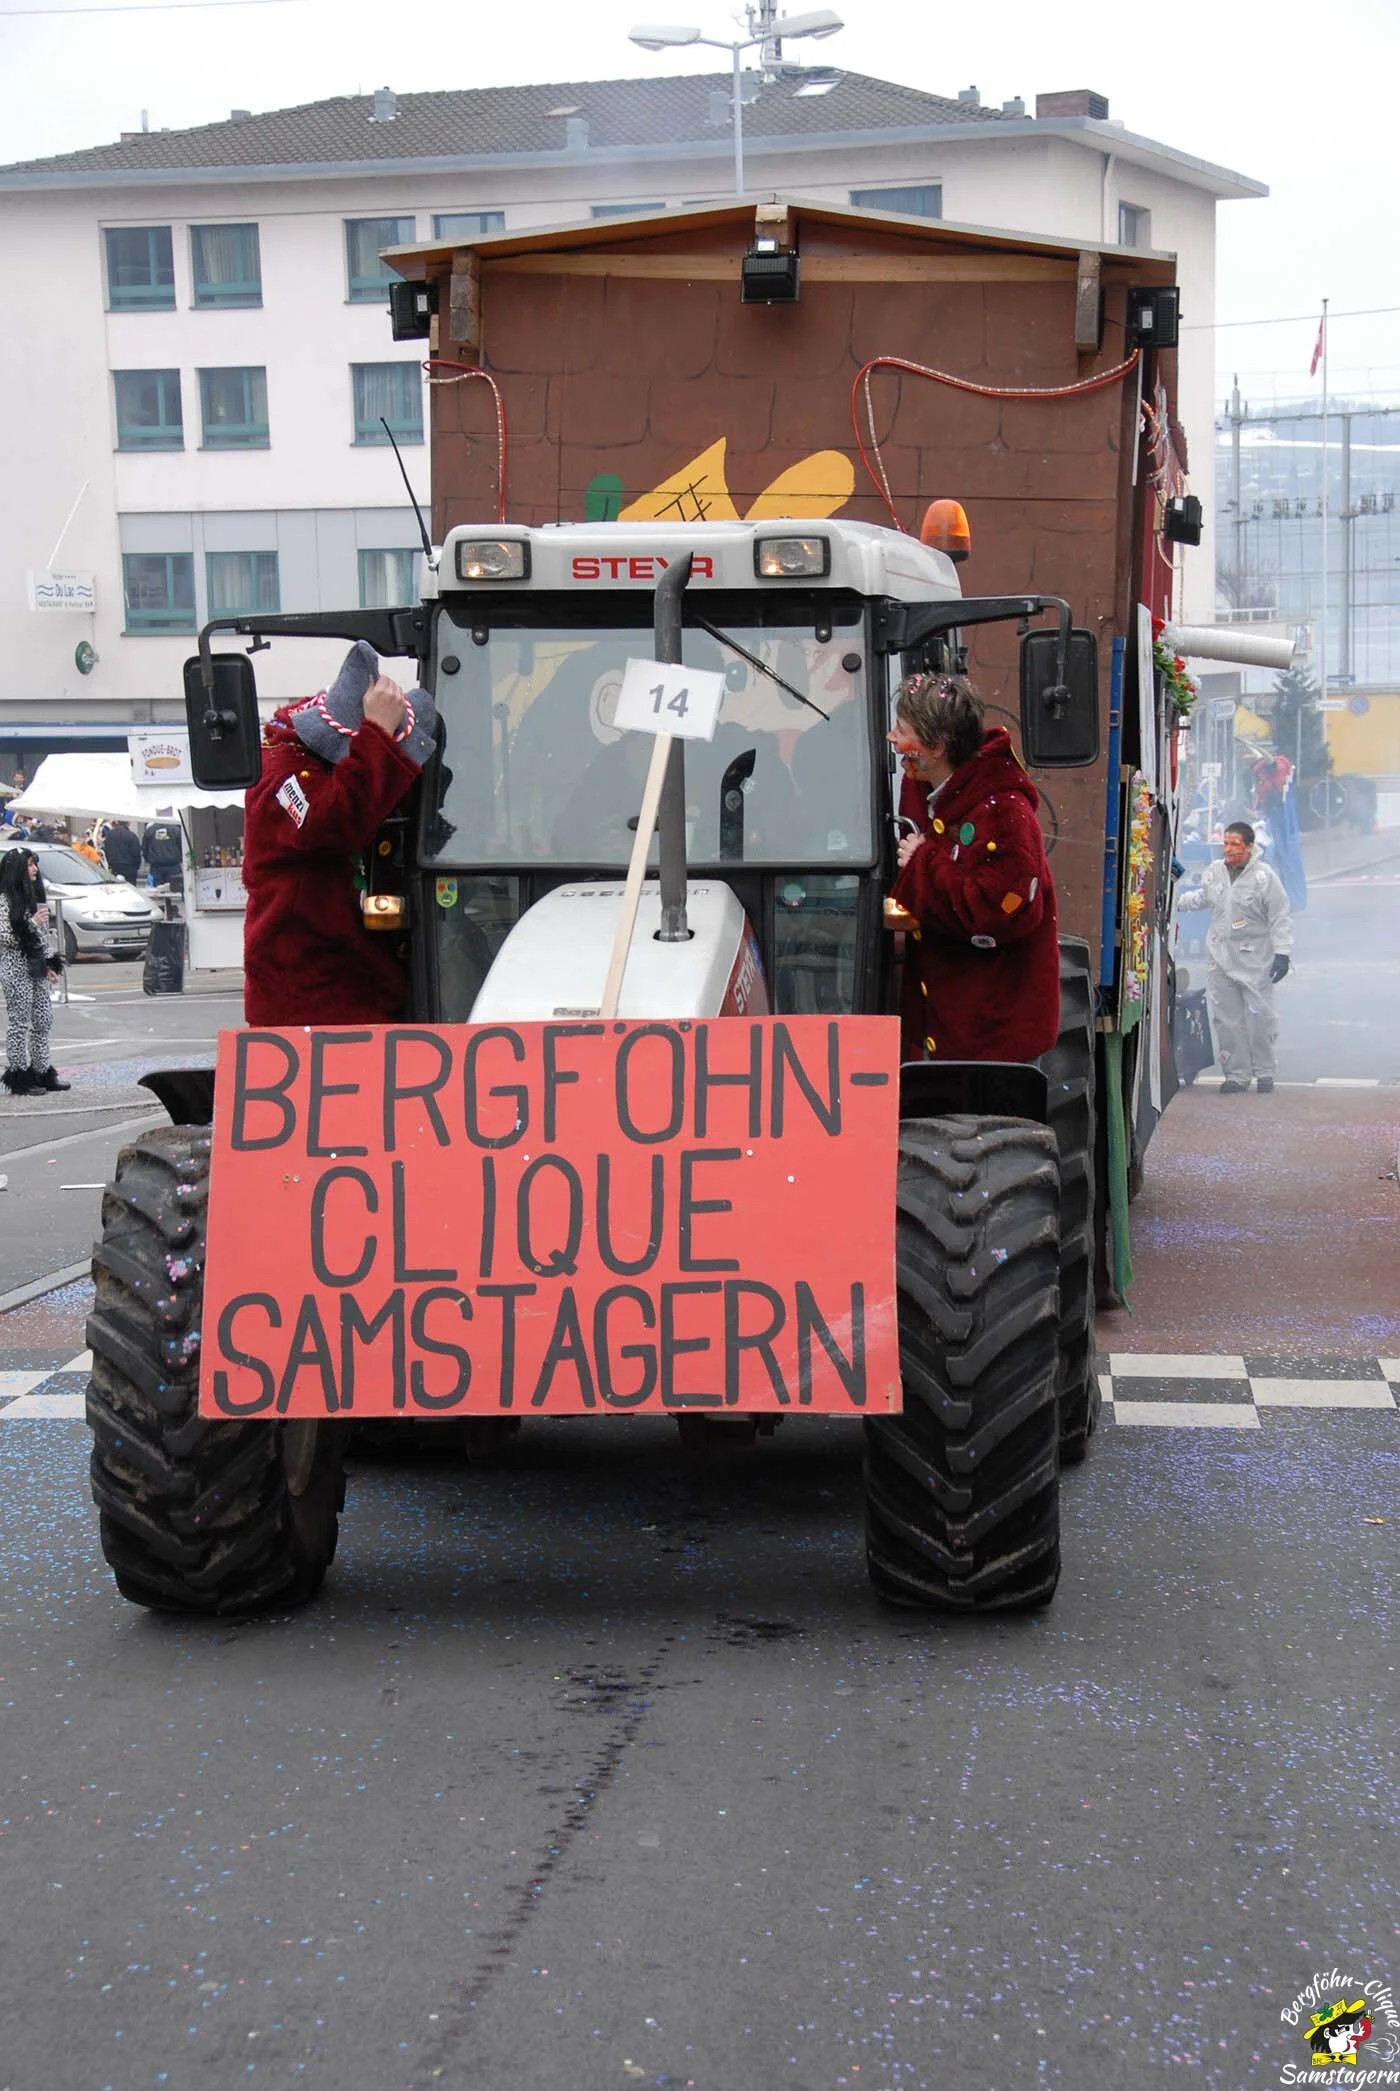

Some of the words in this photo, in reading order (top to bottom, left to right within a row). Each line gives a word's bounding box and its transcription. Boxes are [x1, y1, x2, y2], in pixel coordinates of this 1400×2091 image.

[648, 684, 689, 718] 14
[231, 1022, 889, 1157] BERGFÖHN-
[310, 1148, 742, 1288] CLIQUE
[213, 1280, 866, 1416] SAMSTAGERN
